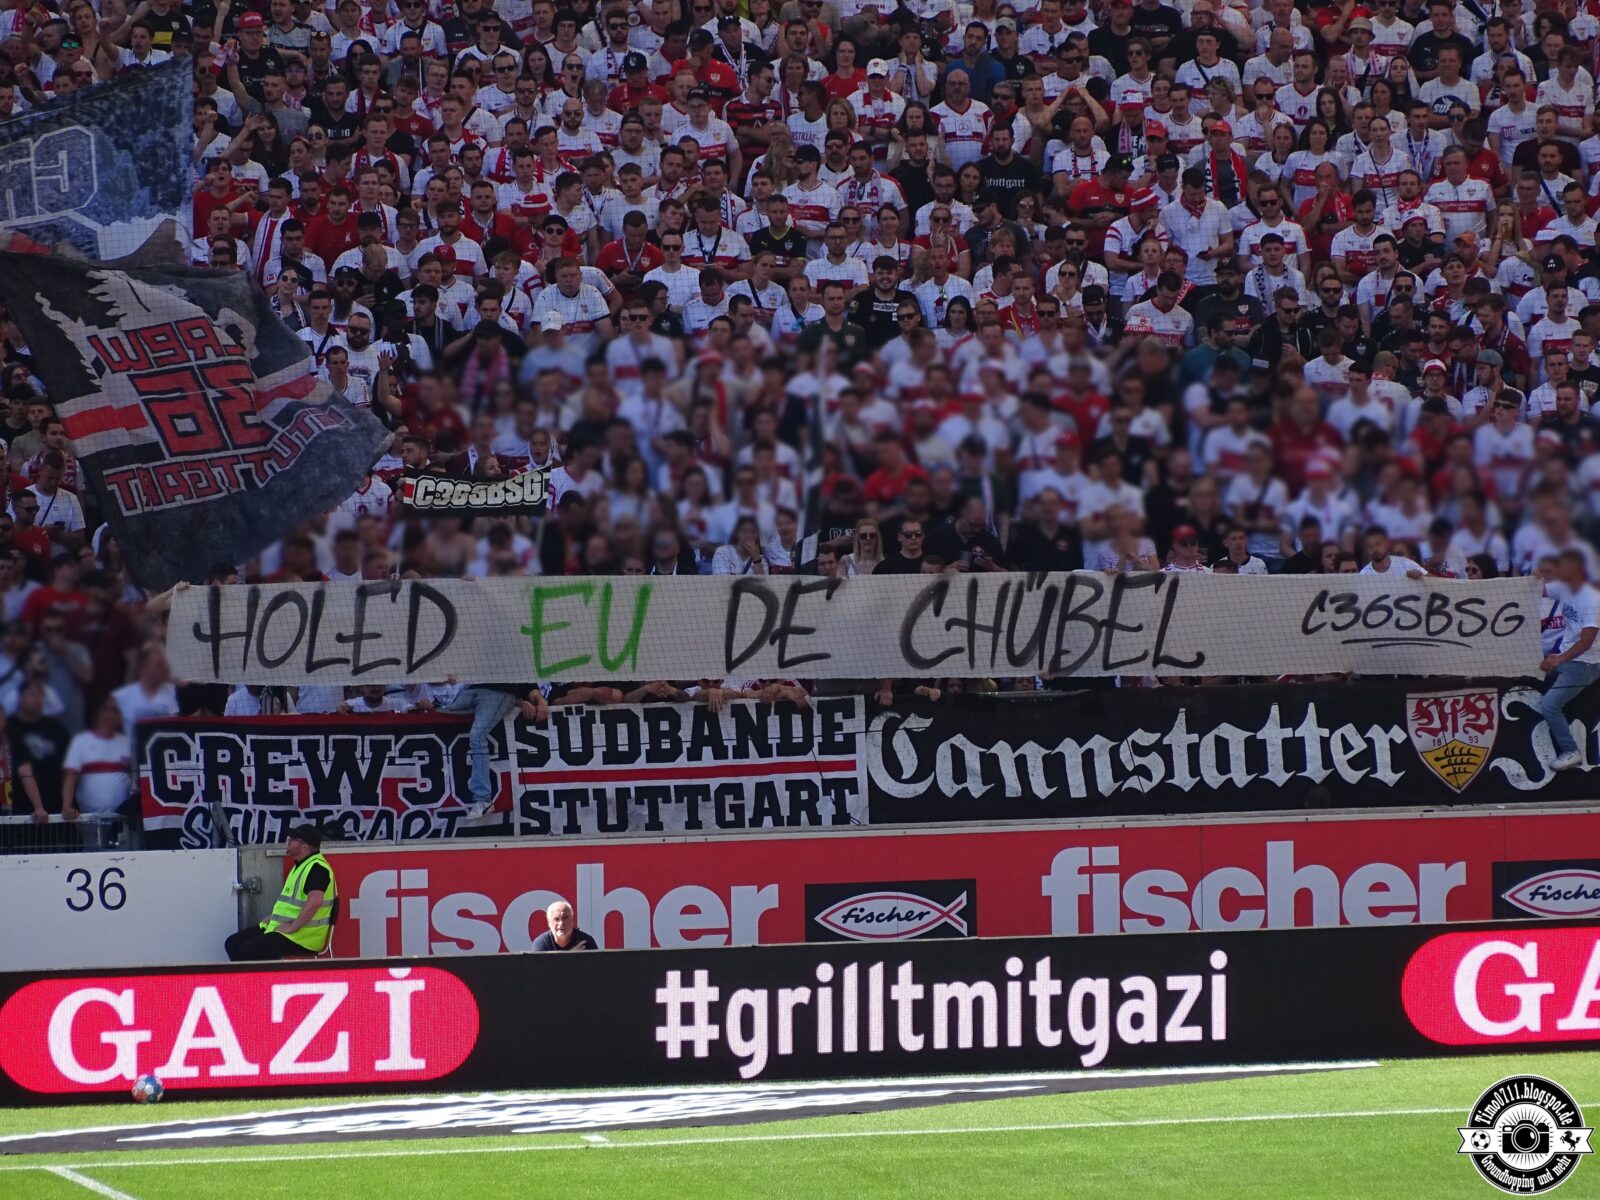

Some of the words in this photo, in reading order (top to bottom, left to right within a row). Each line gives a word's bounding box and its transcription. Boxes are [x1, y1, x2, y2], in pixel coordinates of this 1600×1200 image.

[193, 580, 458, 679] HOLED
[520, 580, 653, 679] EU
[724, 576, 843, 673] DE
[901, 571, 1206, 675] CHÜBEL
[1301, 589, 1525, 637] C36SBSG
[513, 696, 857, 769] SÜDBANDE
[867, 702, 1408, 800] Cannstatter
[519, 776, 860, 836] STUTTGART
[65, 866, 128, 912] 36
[349, 863, 779, 958] fischer
[841, 906, 931, 924] fischer
[1041, 840, 1467, 936] fischer
[655, 949, 1228, 1080] #grilltmitgazi
